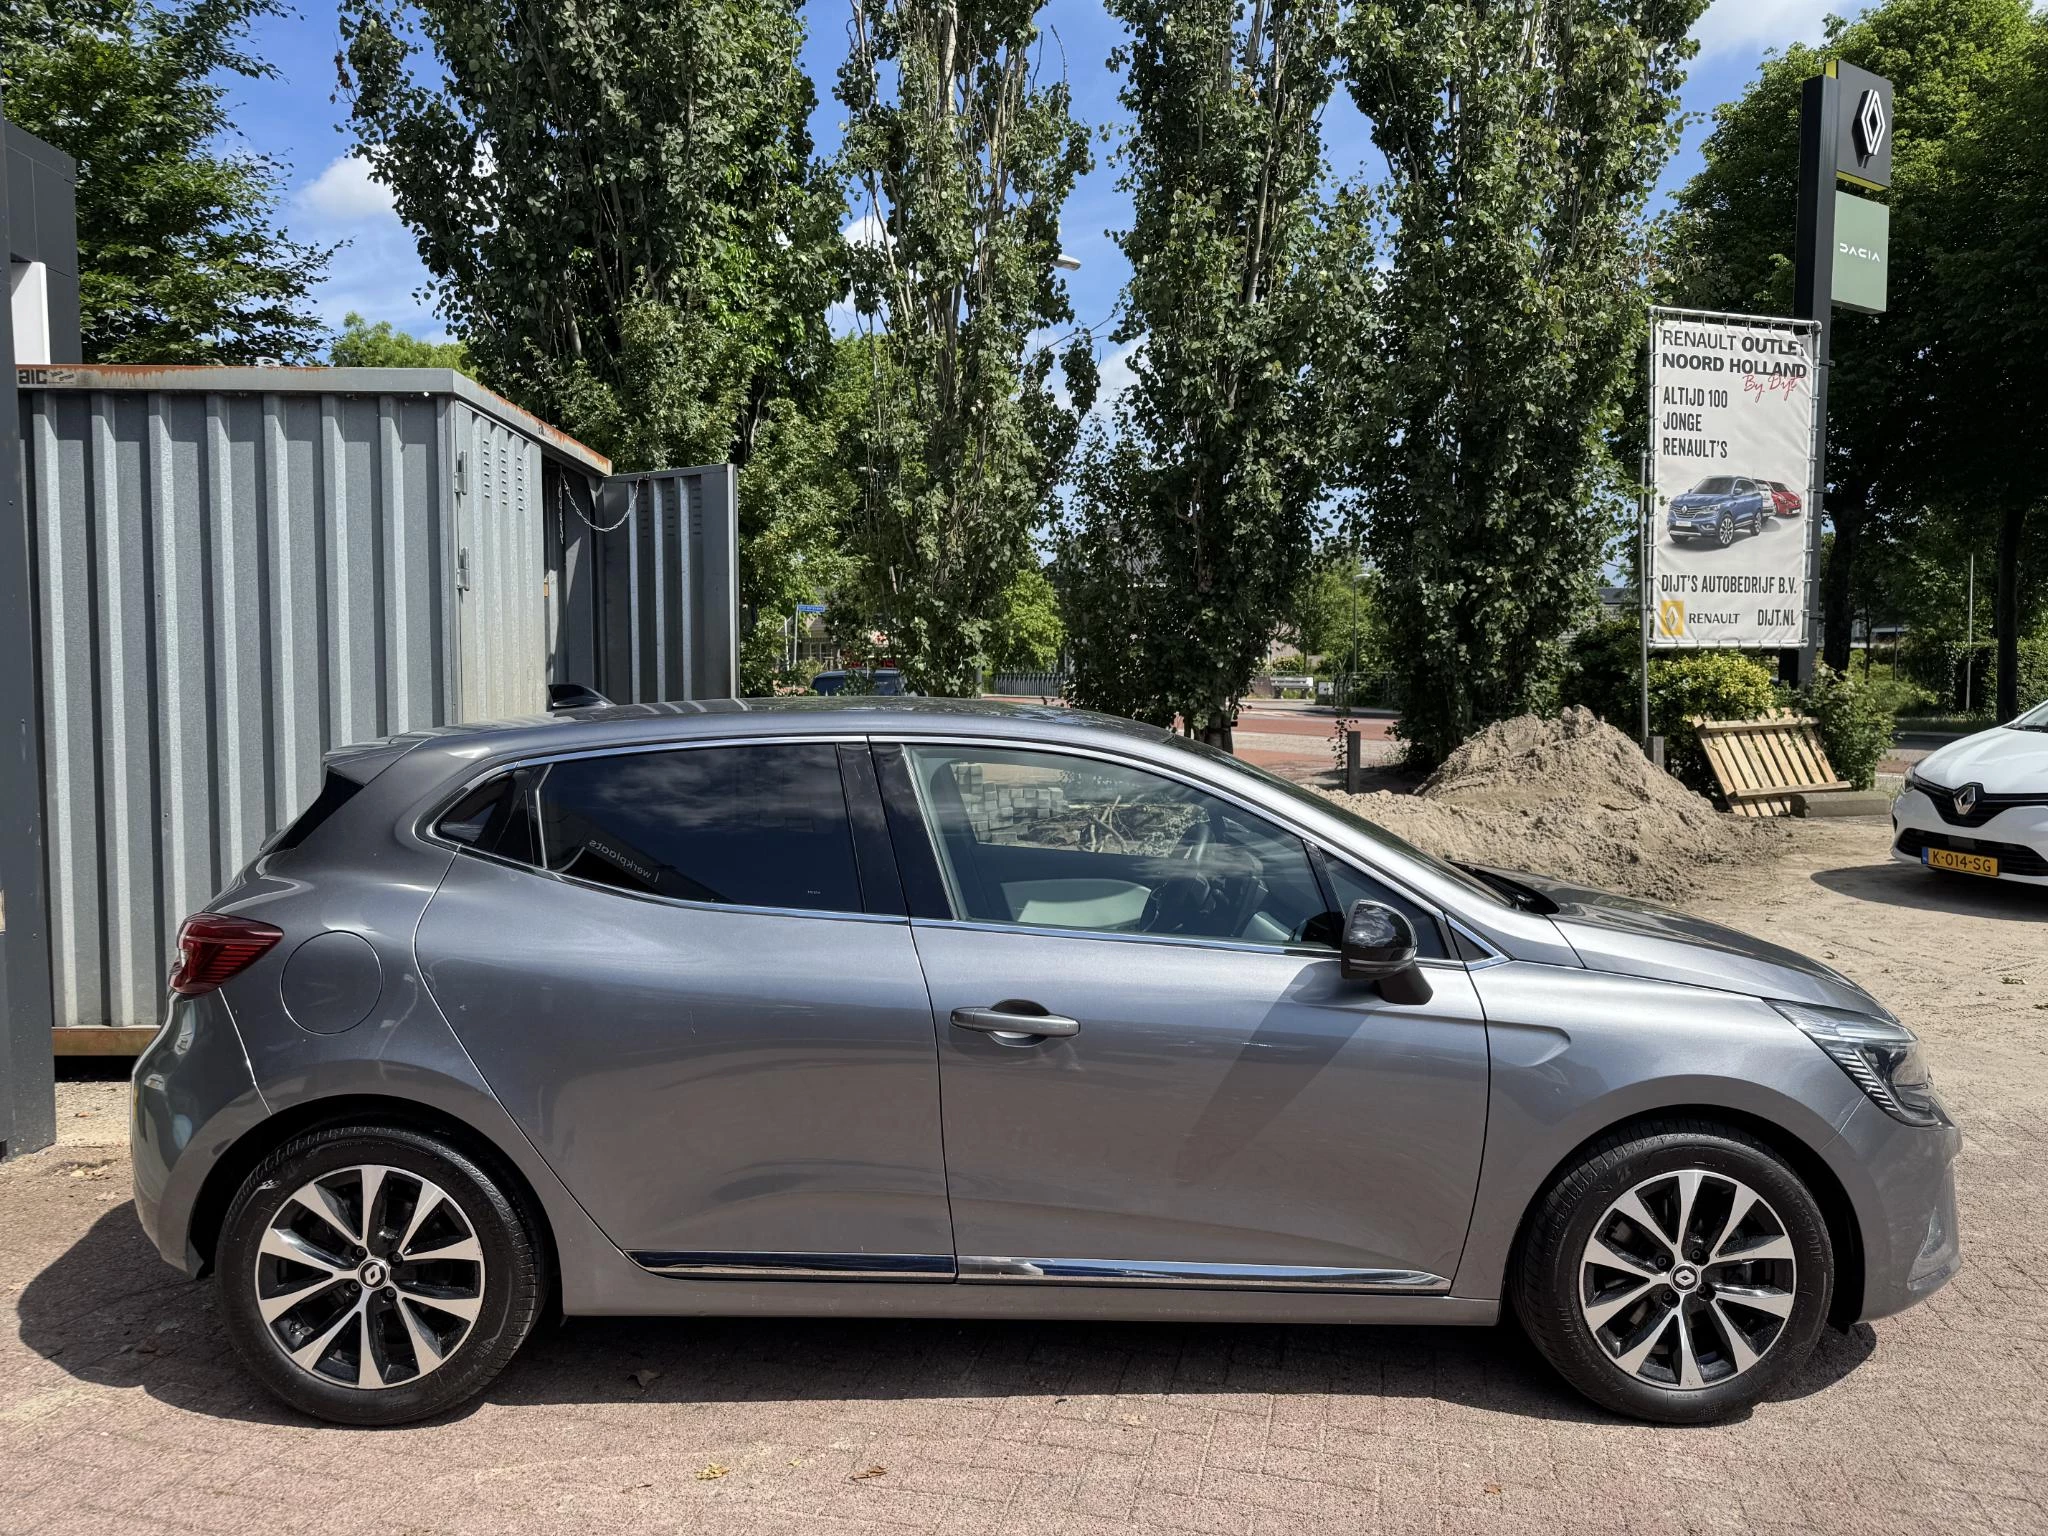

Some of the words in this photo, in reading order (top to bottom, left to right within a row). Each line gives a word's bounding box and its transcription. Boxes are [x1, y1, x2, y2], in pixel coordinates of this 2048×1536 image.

[1839, 243, 1881, 262] DACIA
[1662, 330, 1737, 351] RENAULT
[1662, 353, 1725, 371] NOORD
[1729, 358, 1807, 379] HOLLAND
[1663, 386, 1705, 407] ALTIJD
[1708, 389, 1728, 408] 100
[1742, 374, 1765, 403] By
[1663, 412, 1702, 432] JONGE
[1663, 437, 1728, 459] RENAULT'S
[1661, 574, 1698, 593] DIJT'S
[1701, 576, 1775, 594] AUTOBEDRIJF
[1778, 579, 1797, 594] B.V.
[1689, 613, 1740, 624] RENAULT
[1757, 609, 1796, 626] DIJT.NL
[1933, 850, 1991, 872] K-014-SG
